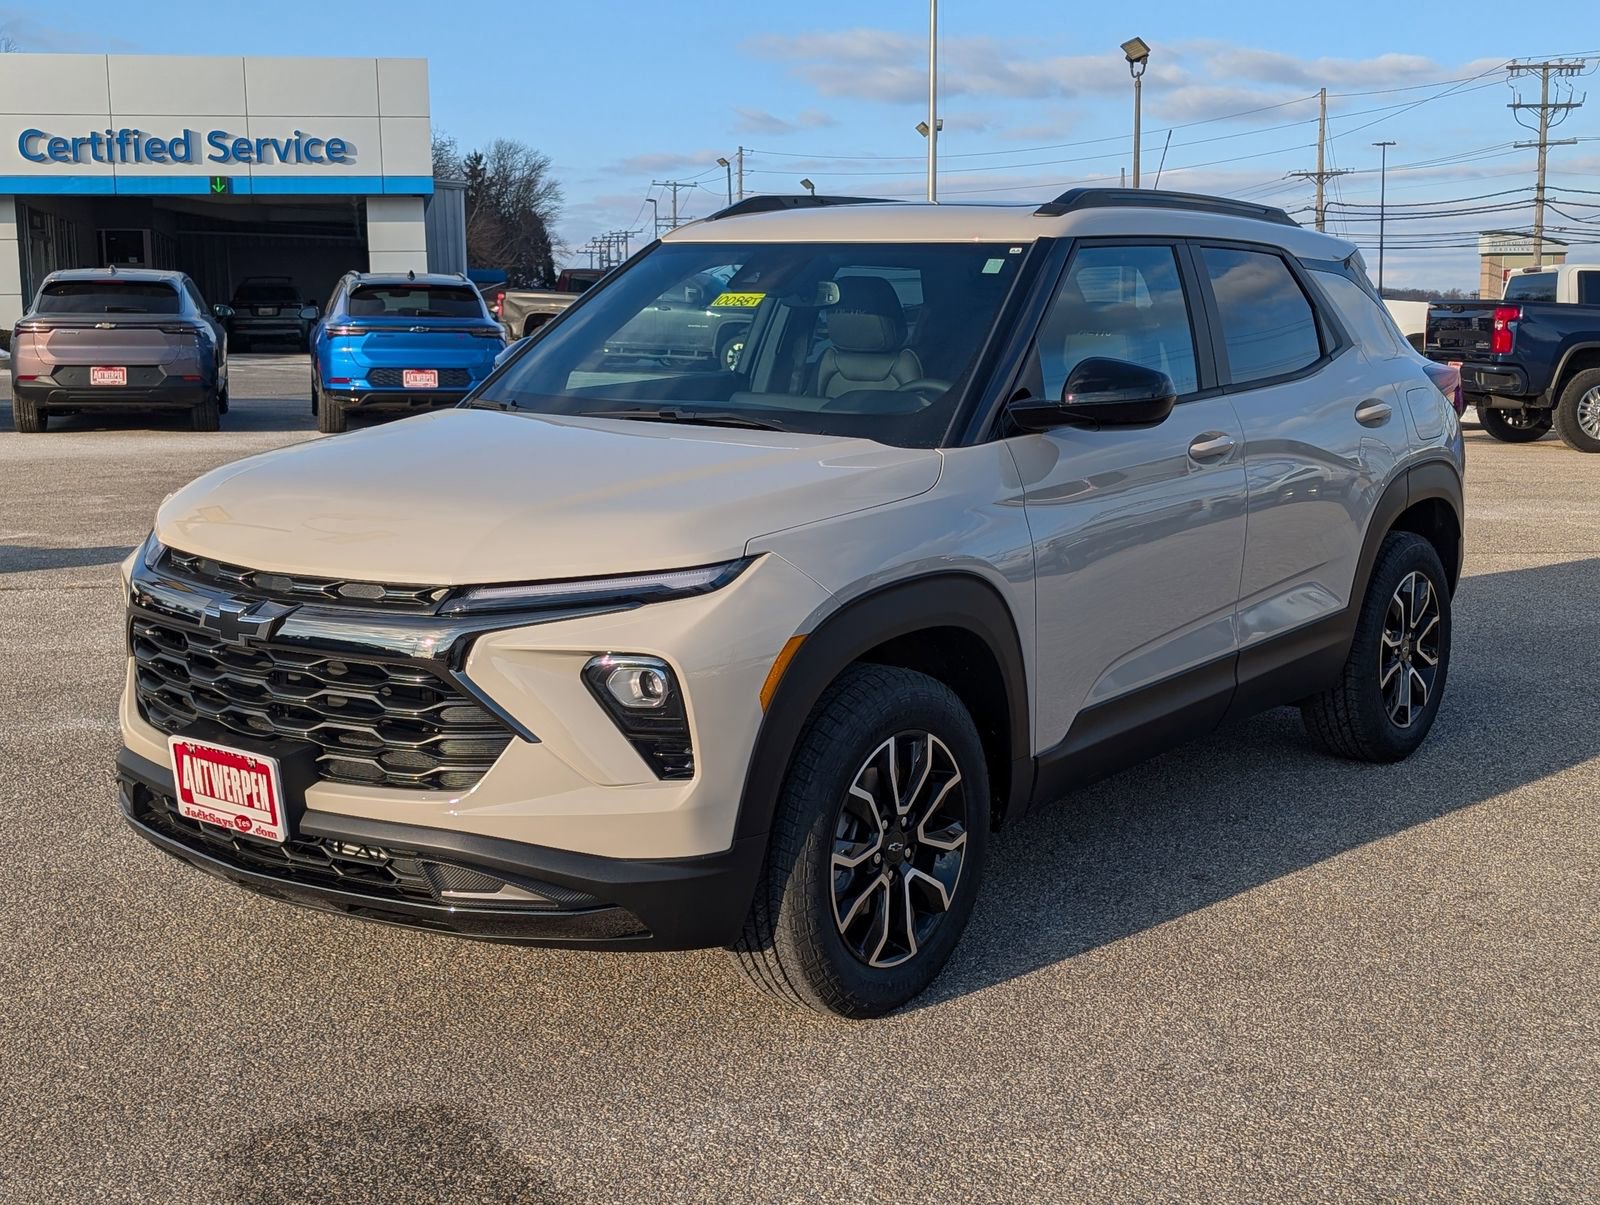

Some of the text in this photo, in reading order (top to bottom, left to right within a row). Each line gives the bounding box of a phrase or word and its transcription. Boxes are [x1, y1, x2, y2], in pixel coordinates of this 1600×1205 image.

[18, 128, 348, 163] Certified Service
[182, 754, 271, 811] ANTWERPEN
[184, 807, 234, 829] JackSays
